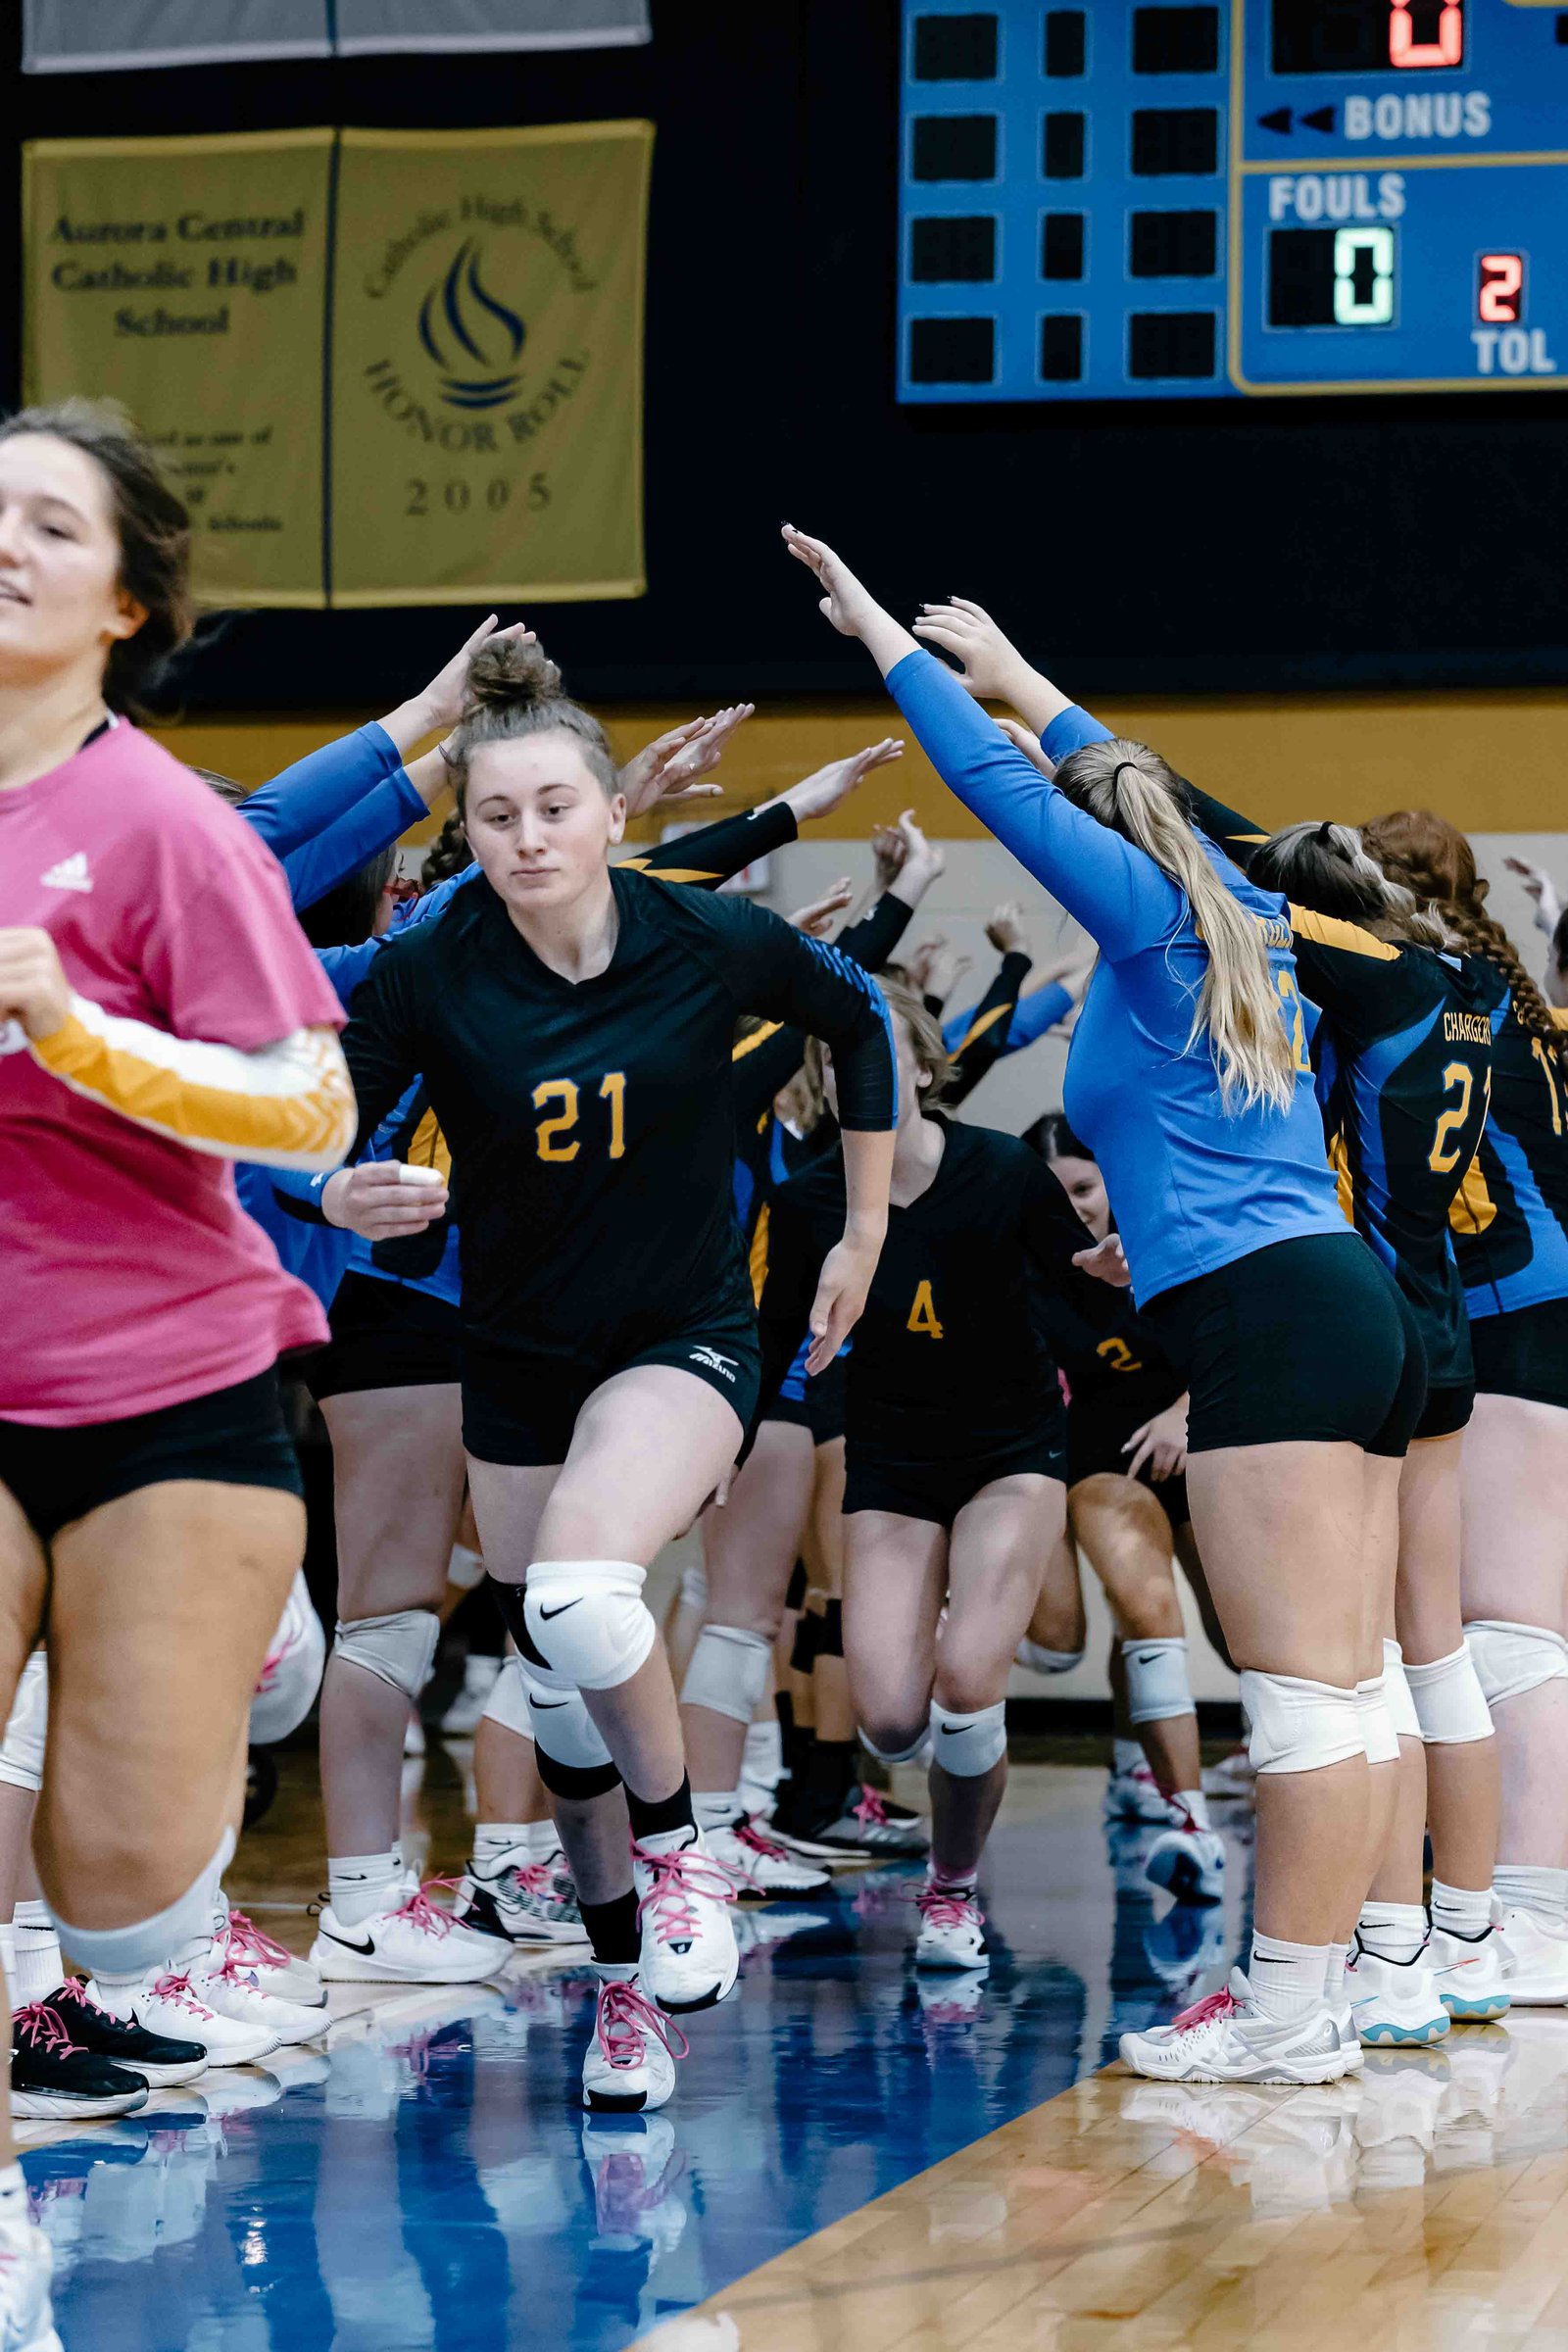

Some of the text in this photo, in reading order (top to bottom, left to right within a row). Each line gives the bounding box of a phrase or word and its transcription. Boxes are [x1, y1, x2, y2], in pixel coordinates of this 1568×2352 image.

[1344, 91, 1492, 140] BONUS
[1268, 172, 1406, 221] FOULS
[177, 208, 304, 241] Central
[52, 256, 297, 295] Catholic High
[1334, 226, 1395, 325] 0
[1479, 255, 1522, 322] 2
[115, 306, 230, 336] School
[1470, 327, 1557, 374] TOL
[364, 358, 500, 453] HONOR
[406, 472, 553, 516] 2005
[1444, 1011, 1492, 1046] CHARGER
[531, 1071, 626, 1162] 21
[906, 1279, 945, 1340] 4
[1096, 1337, 1143, 1372] 2
